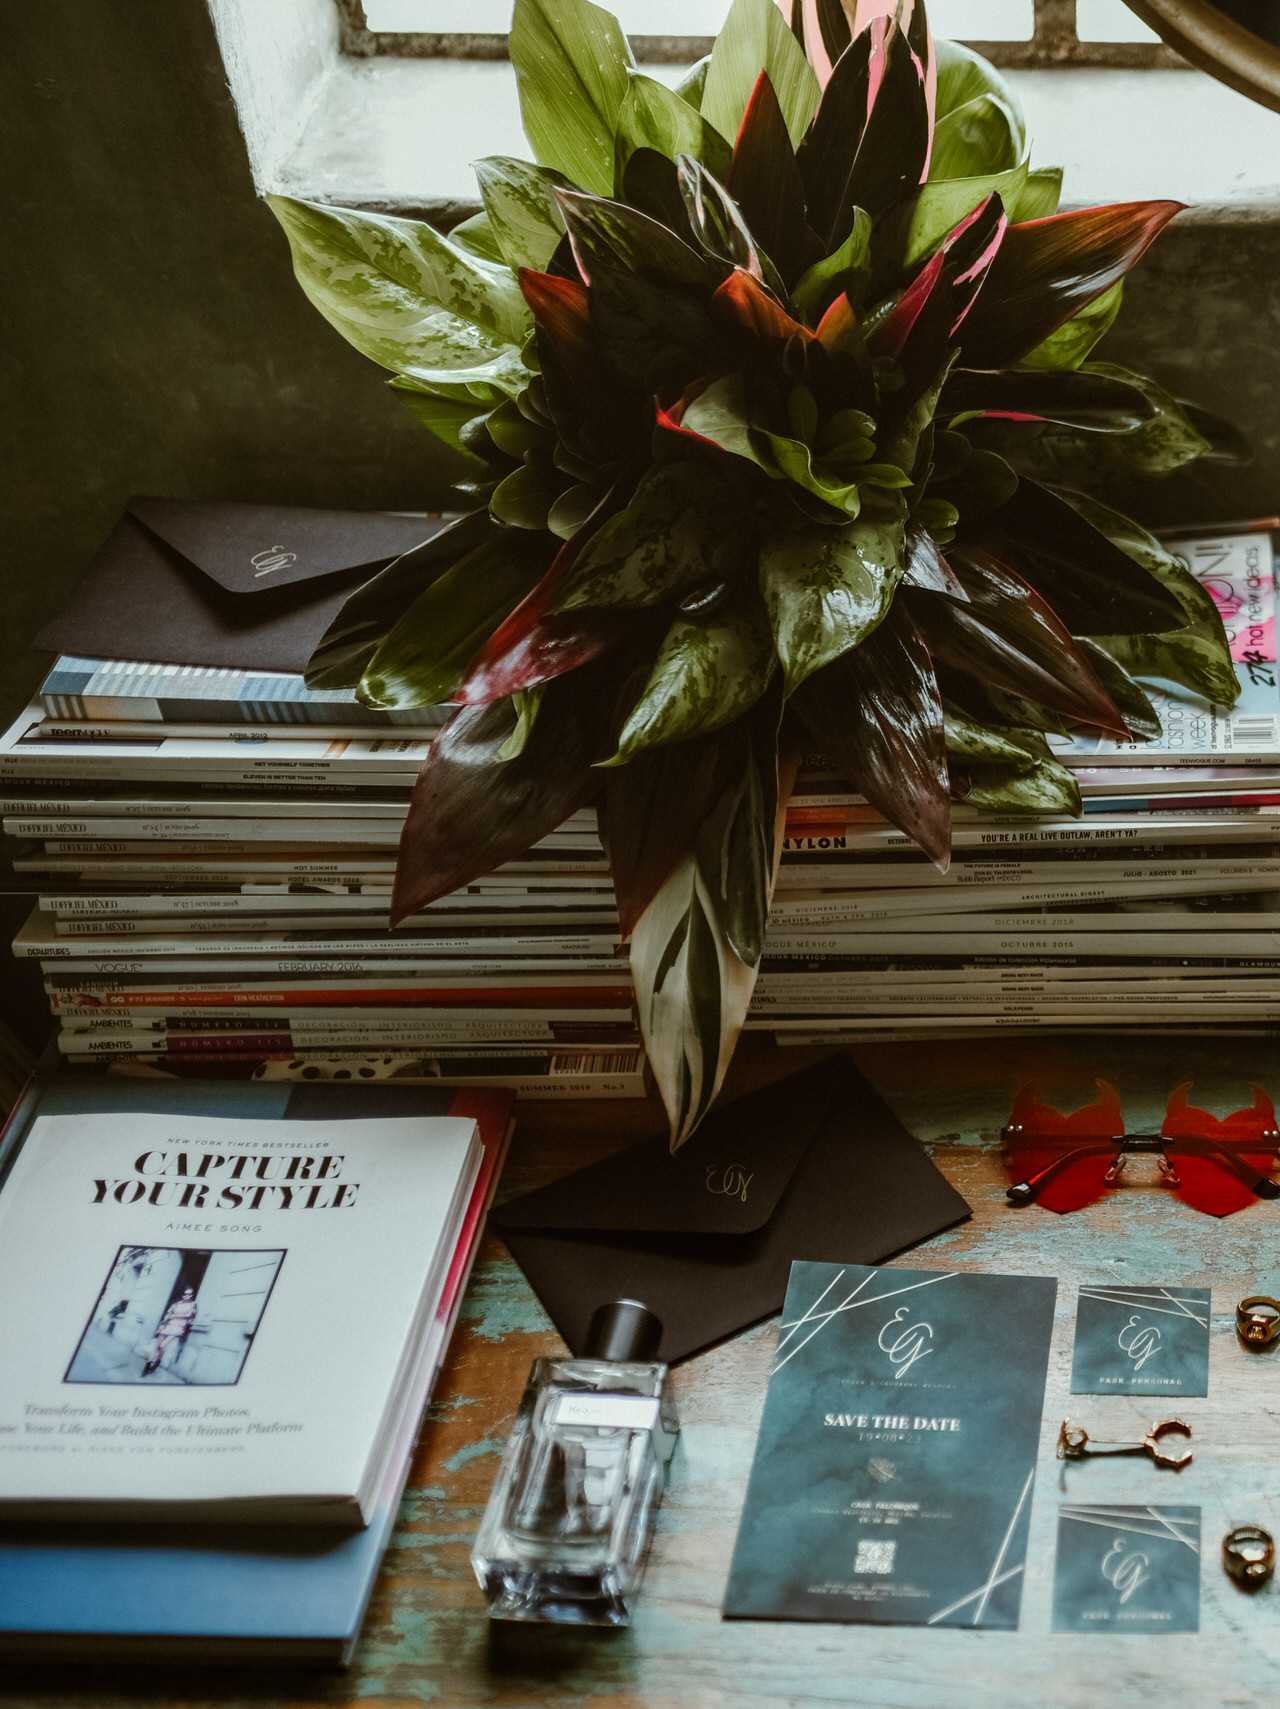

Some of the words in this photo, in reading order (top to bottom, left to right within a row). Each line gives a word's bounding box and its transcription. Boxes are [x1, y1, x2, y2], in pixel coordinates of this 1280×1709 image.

[1243, 546, 1262, 592] ideas
[1248, 594, 1262, 622] new
[1244, 624, 1265, 647] hot
[1243, 650, 1277, 688] 274
[1162, 700, 1185, 751] fashion
[1189, 713, 1207, 749] week
[228, 732, 249, 740] APRIL
[40, 802, 70, 812] MÉXICO
[56, 822, 87, 833] MÉXICO
[981, 833, 1010, 844] YOU'RE
[1018, 832, 1039, 843] REAL
[1040, 831, 1059, 842] LIVE
[1059, 830, 1094, 841] OUTLAW,
[1094, 829, 1123, 840] AREN'T
[1123, 828, 1138, 839] YA?
[96, 842, 126, 853] MÉXICO
[782, 836, 847, 850] NYLON
[1021, 892, 1079, 901] ARCHITECTURAL
[1080, 890, 1106, 898] DIGEST
[87, 898, 118, 909] MÉXICO
[795, 906, 838, 914] DICIEMBRE
[105, 921, 136, 932] MÉXICO
[27, 947, 71, 956] DEPARTURES
[1000, 941, 1048, 949] OCTUBRE
[277, 962, 335, 972] FEBRUARY
[336, 962, 364, 972] 2016
[89, 1020, 134, 1028] AMBIENTES
[378, 1021, 453, 1029] INTERIORISMO
[465, 1022, 543, 1030] ARQUITECTURA
[88, 1041, 133, 1050] AMBIENTES
[300, 1034, 369, 1044] DECORACIÓN
[381, 1032, 457, 1041] INTERIORISMO
[469, 1029, 548, 1039] ARQUITECTURA
[519, 1084, 566, 1092] SUMMER
[167, 1137, 190, 1147] NEW
[193, 1139, 223, 1149] YORK
[226, 1141, 260, 1150] TIMES
[262, 1141, 331, 1150] BESTSELLER
[134, 1149, 347, 1181] CAPTURE
[88, 1178, 213, 1208] YOUR
[214, 1183, 361, 1211] STYLE
[165, 1222, 212, 1233] AIMEE
[219, 1223, 263, 1234] SONG
[24, 1401, 94, 1417] Transform
[98, 1404, 129, 1418] Your
[131, 1406, 200, 1421] Instagram
[24, 1422, 57, 1434] Your
[89, 1424, 119, 1436] and
[120, 1423, 158, 1436] Build
[159, 1424, 183, 1436] the
[185, 1424, 243, 1436] Ultimate
[245, 1422, 303, 1434] Platform
[823, 1413, 871, 1428] SAVE
[871, 1414, 911, 1431] THE
[912, 1416, 961, 1433] DATE
